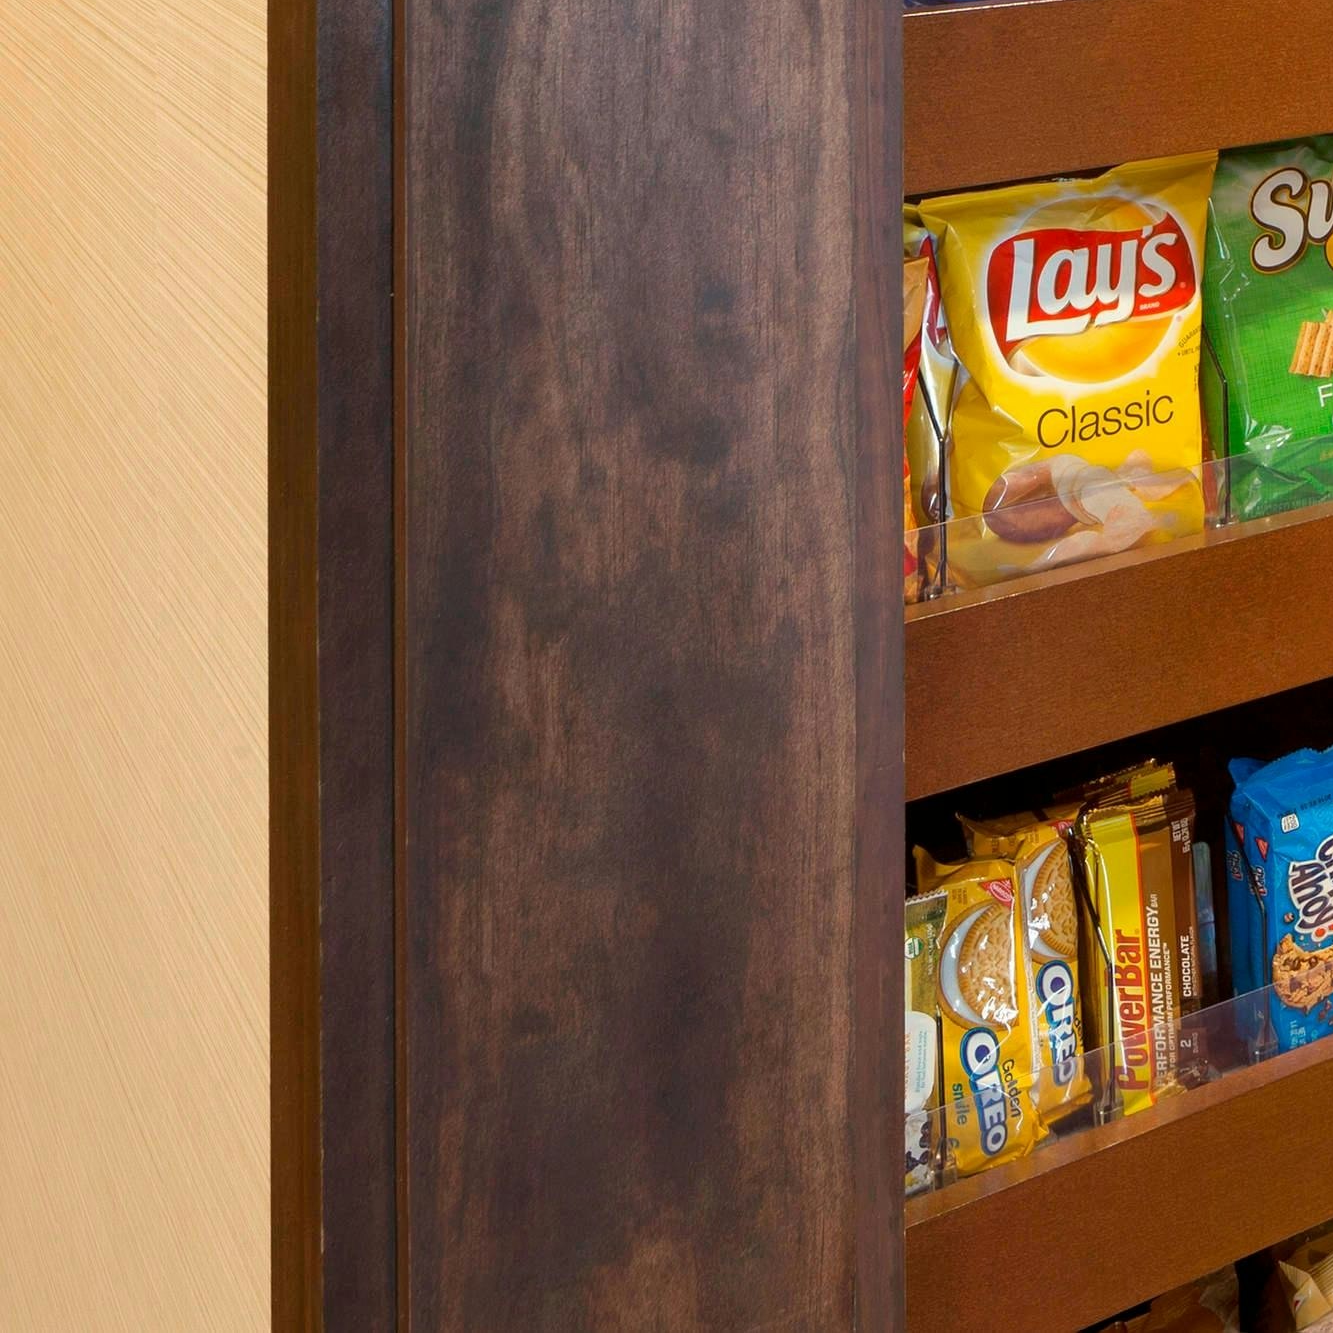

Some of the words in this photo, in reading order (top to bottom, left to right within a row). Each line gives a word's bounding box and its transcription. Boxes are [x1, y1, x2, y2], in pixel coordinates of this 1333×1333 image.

[1007, 224, 1178, 343] Lay's
[1036, 389, 1175, 450] Classic
[1146, 906, 1162, 969] ENERGY
[1180, 935, 1192, 997] CHOCOLATE
[1115, 929, 1149, 1090] PowerBar
[960, 1027, 1008, 1156] OREO
[1001, 1059, 1021, 1118] Golden
